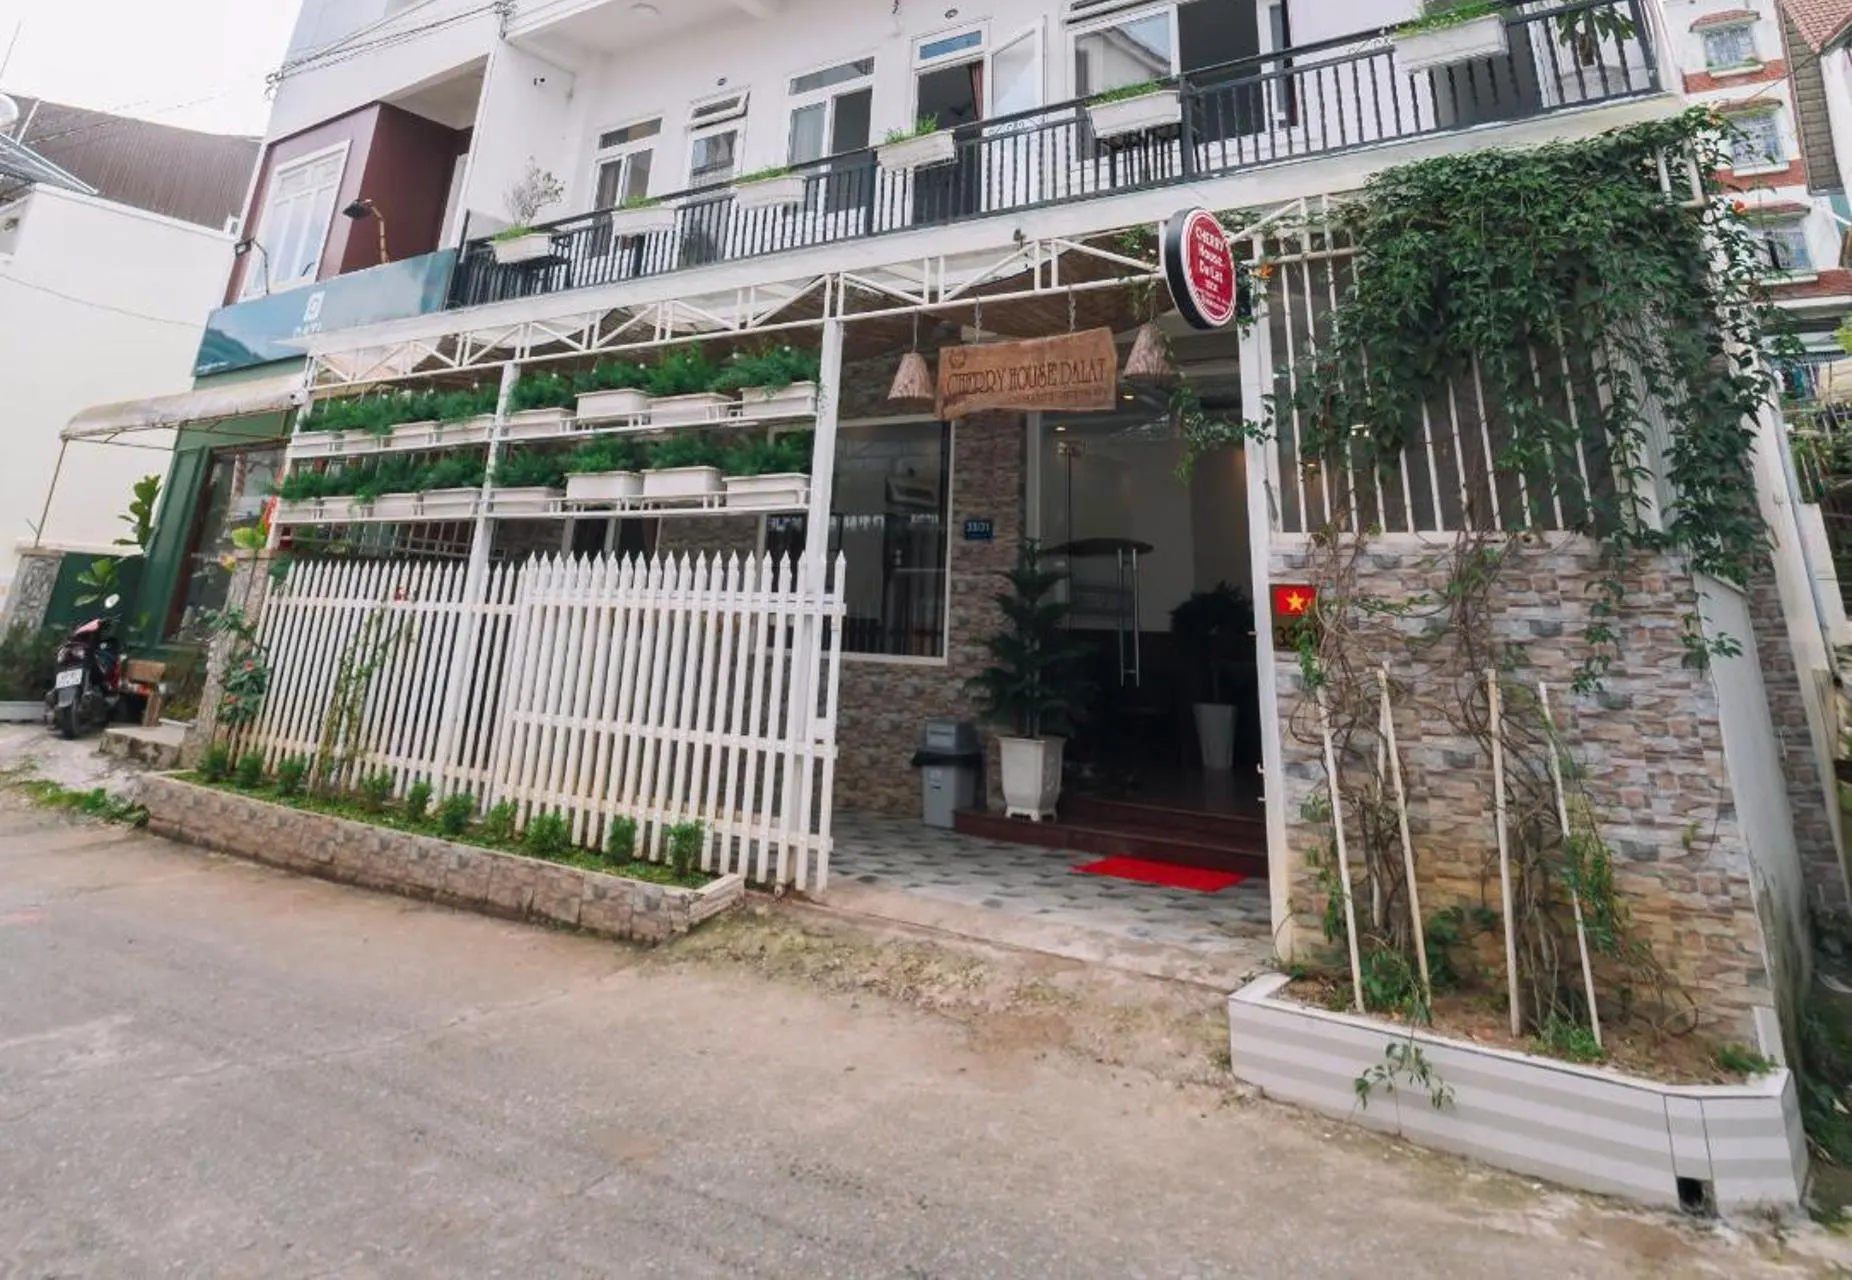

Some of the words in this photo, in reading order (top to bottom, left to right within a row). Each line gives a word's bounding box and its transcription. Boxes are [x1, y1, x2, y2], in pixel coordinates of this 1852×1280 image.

[946, 367, 1007, 396] CHERRY
[1009, 363, 1057, 391] HOUSE
[1060, 358, 1106, 386] DALAT
